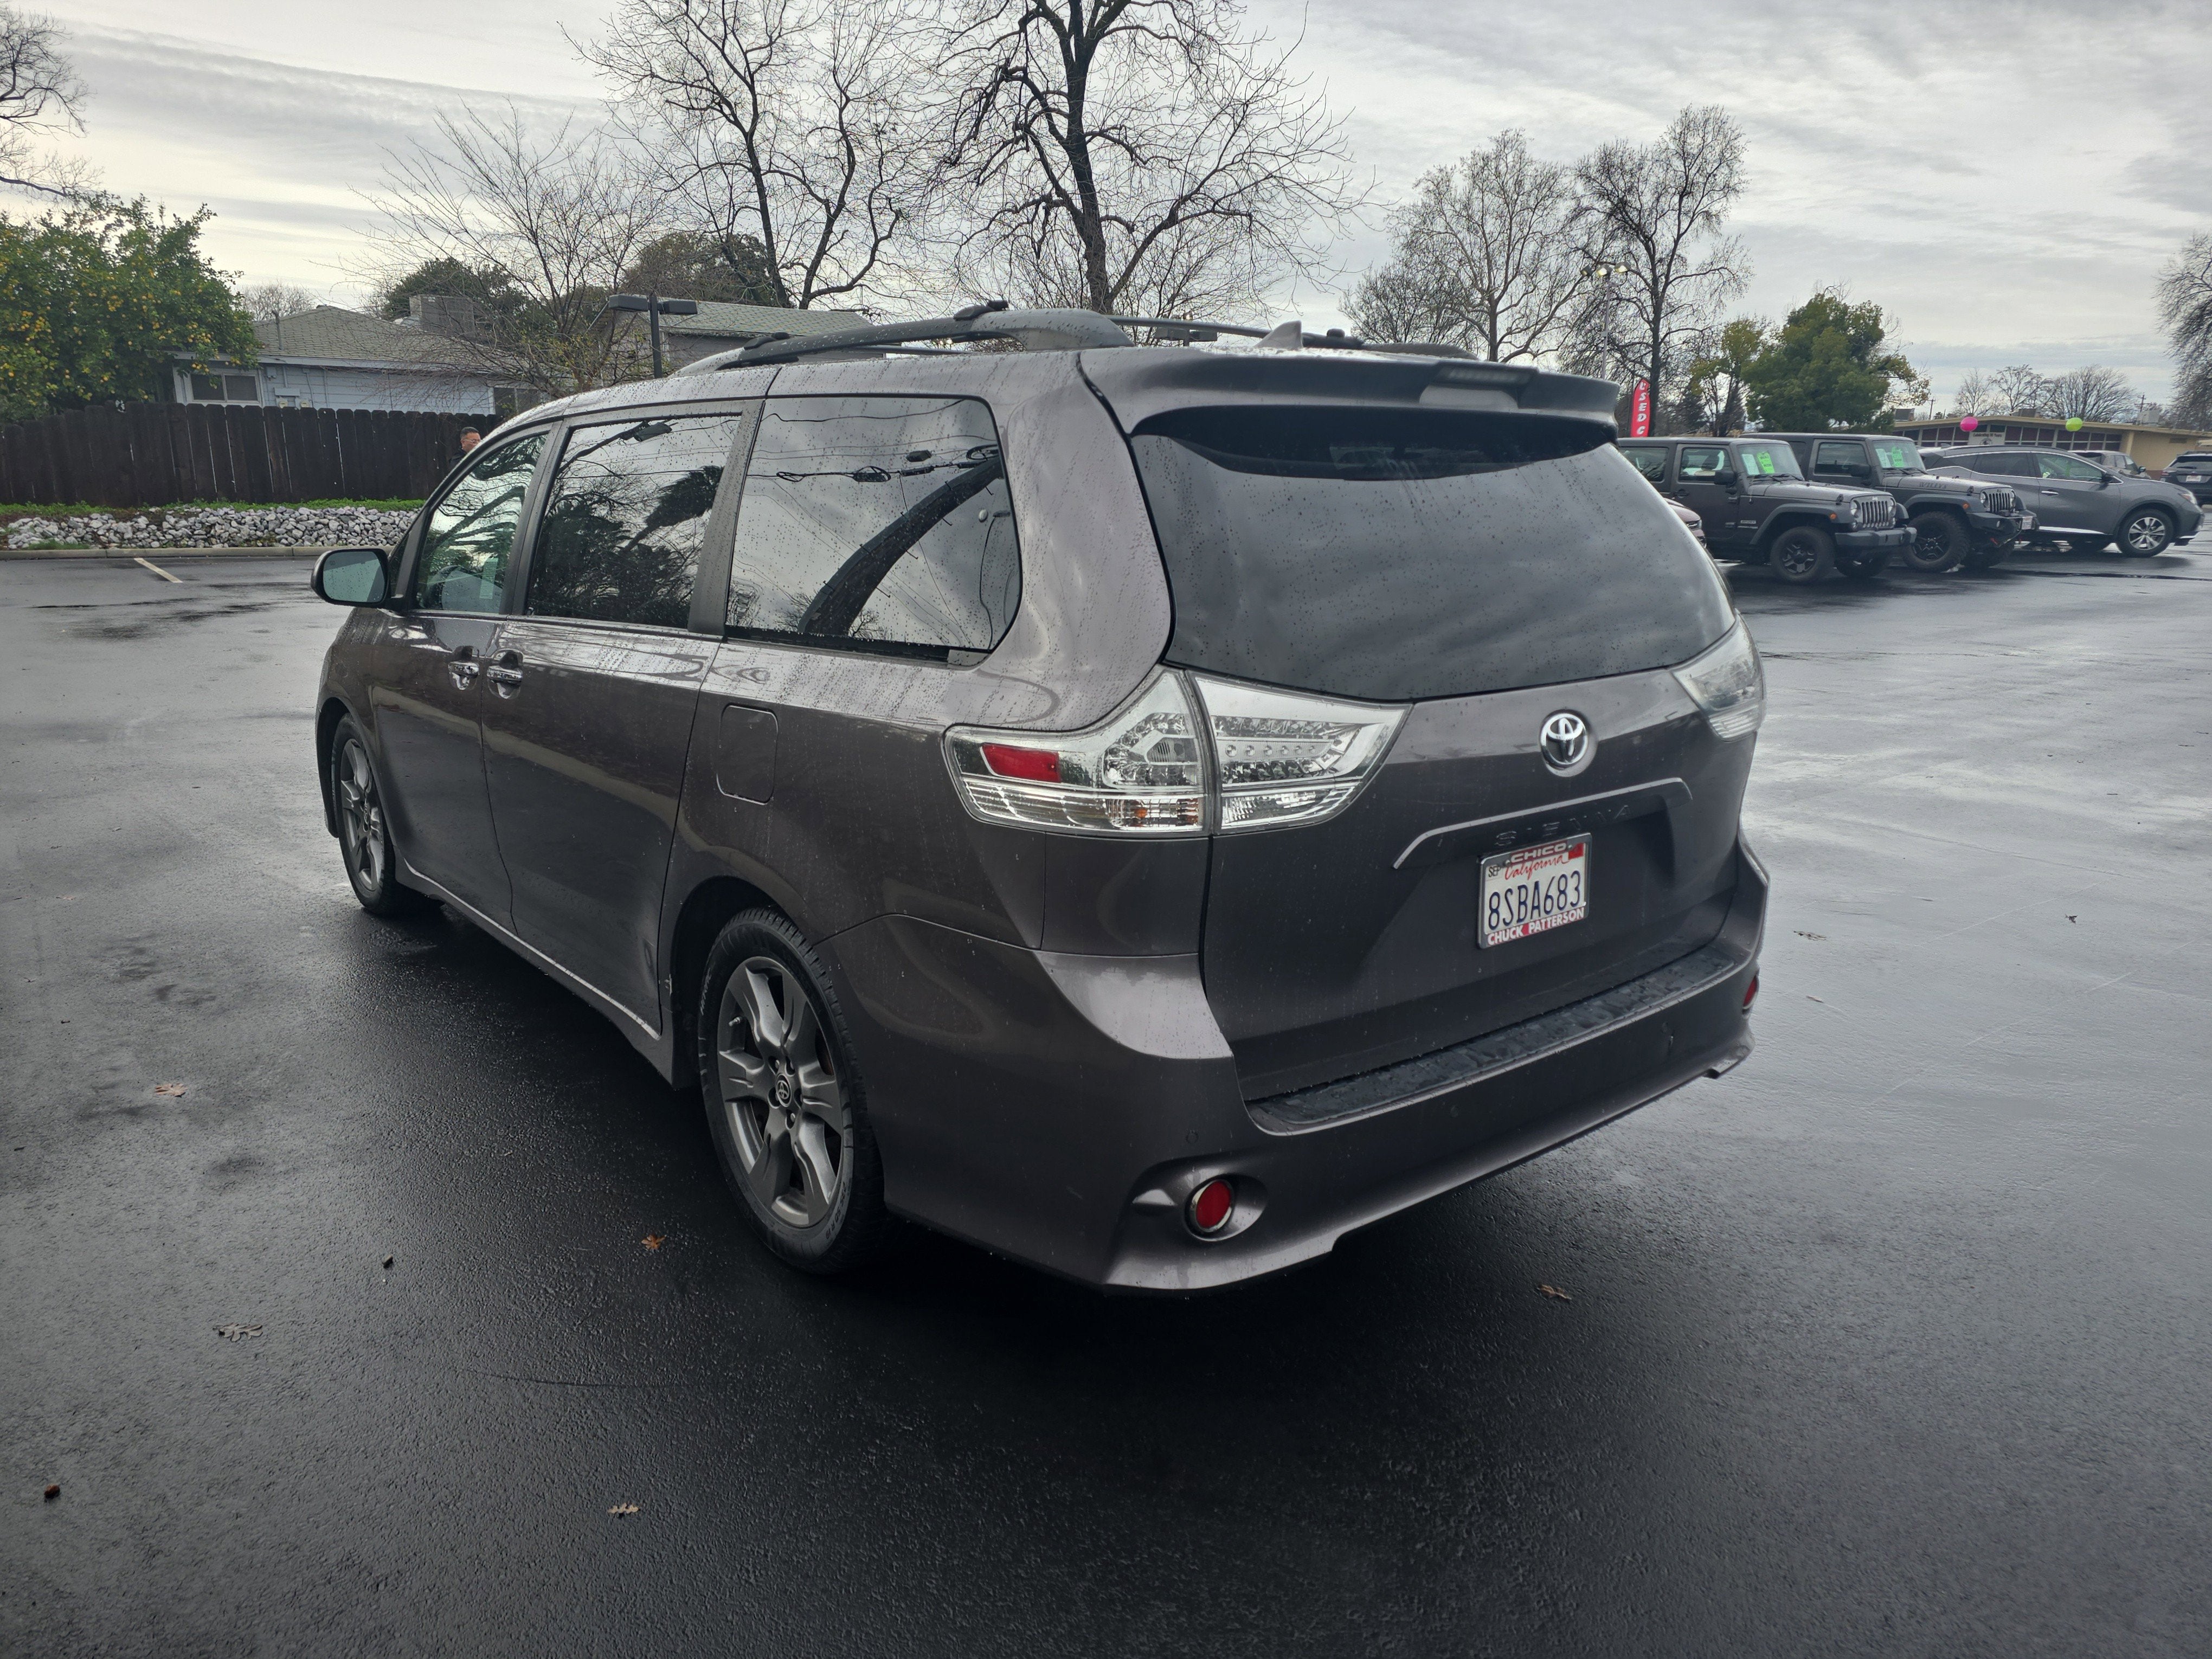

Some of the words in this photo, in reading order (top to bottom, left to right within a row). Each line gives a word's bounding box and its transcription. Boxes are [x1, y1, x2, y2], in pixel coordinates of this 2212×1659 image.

[1637, 382, 1647, 422] USED
[1637, 426, 1645, 436] C
[1495, 805, 1631, 846] SENNA
[1504, 854, 1570, 880] California
[1510, 843, 1566, 863] CHICO
[1488, 865, 1501, 878] SEP
[1488, 870, 1581, 930] 8SBA683
[1488, 925, 1524, 946] CHUCK
[1528, 907, 1585, 934] PATTERSON
